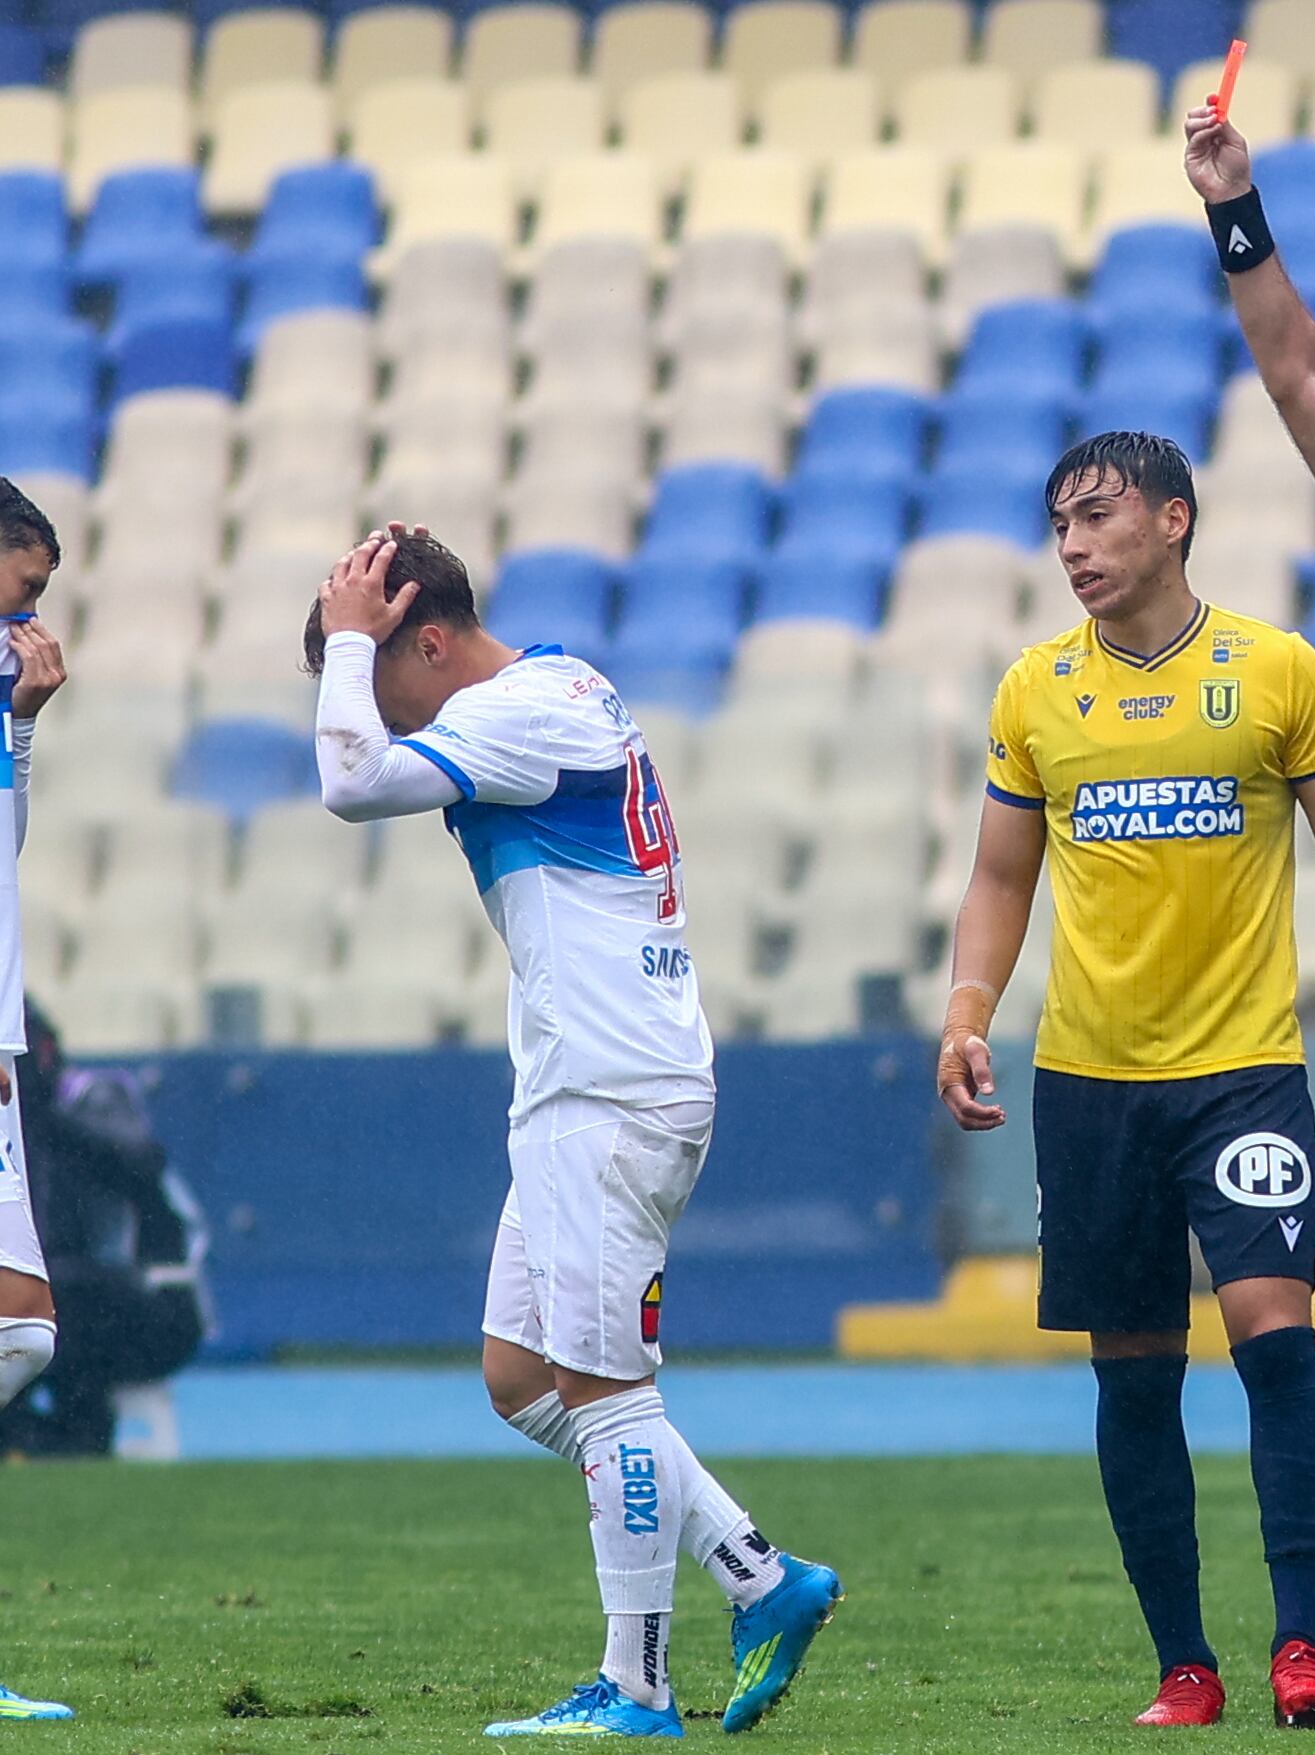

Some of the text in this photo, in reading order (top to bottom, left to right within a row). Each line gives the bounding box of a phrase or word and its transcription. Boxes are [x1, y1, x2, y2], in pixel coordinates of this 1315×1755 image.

[1212, 636, 1256, 647] Del Sur
[1118, 694, 1176, 709] energy
[1076, 780, 1235, 811] APUESTAS
[1072, 808, 1241, 839] ROYAL.COM
[1239, 1145, 1294, 1195] PF
